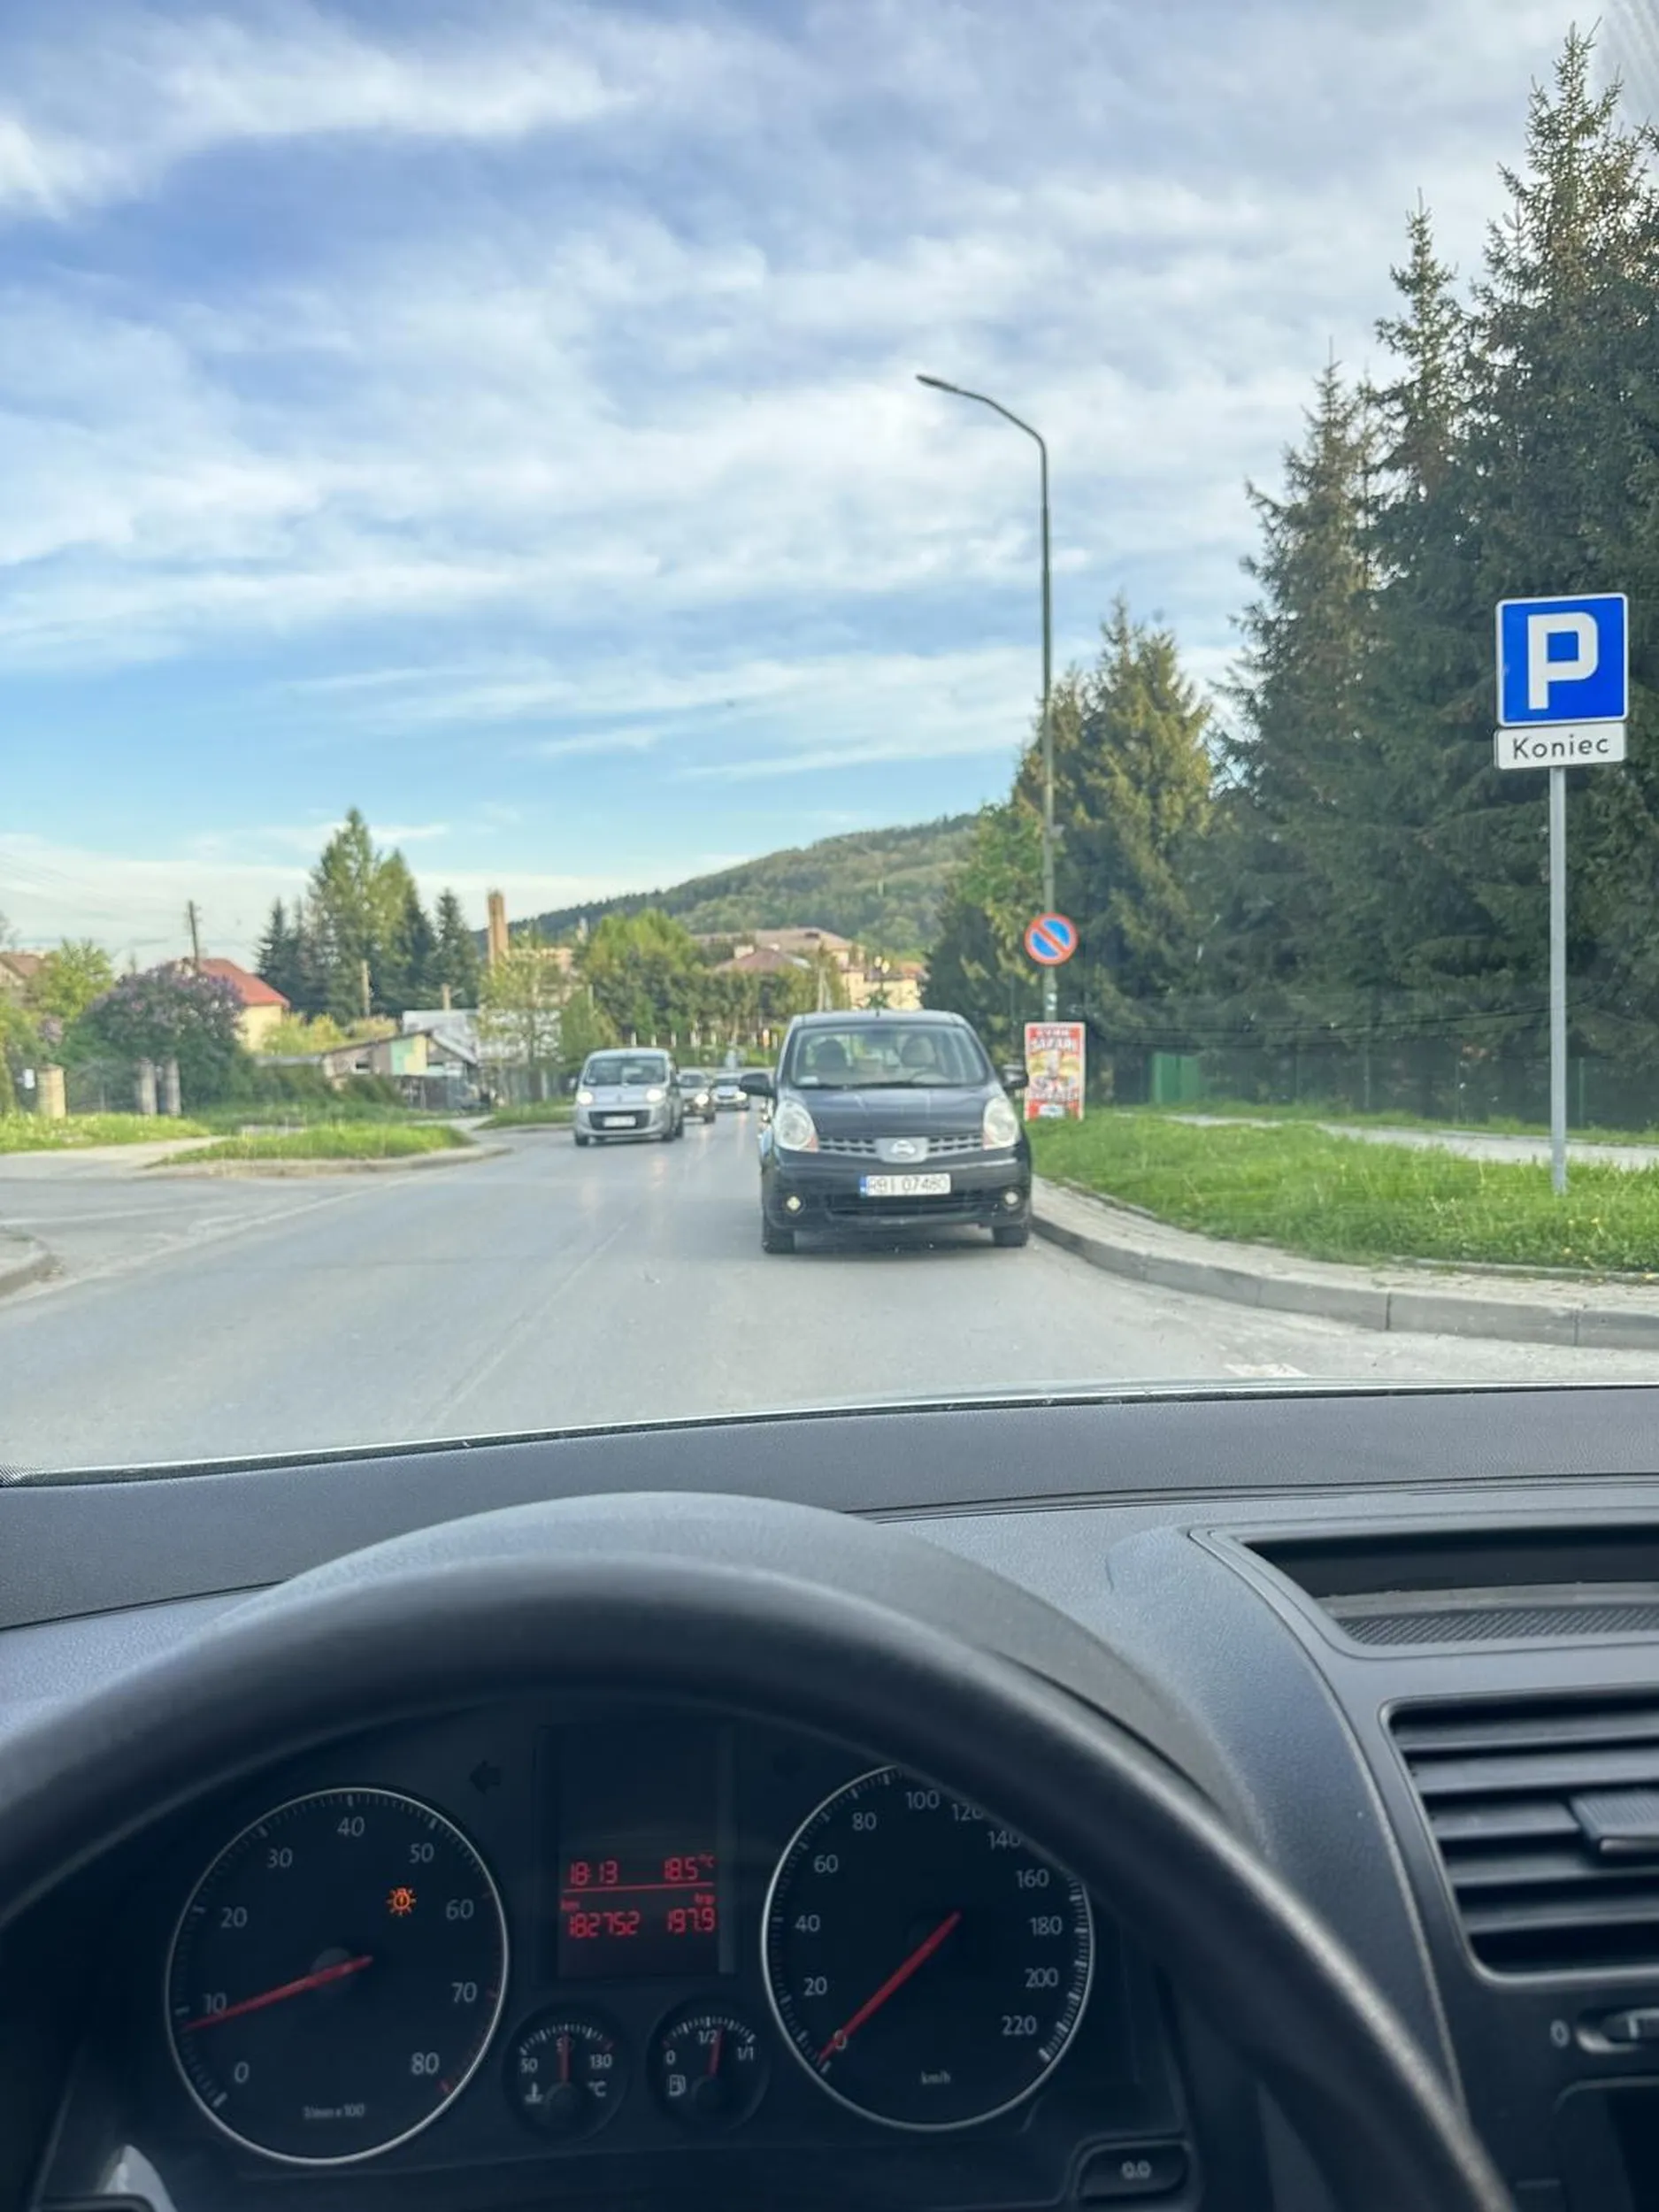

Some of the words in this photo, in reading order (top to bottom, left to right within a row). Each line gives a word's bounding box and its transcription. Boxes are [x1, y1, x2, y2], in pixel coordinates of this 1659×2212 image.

[1528, 611, 1599, 710] P
[1514, 734, 1609, 759] Koniec
[906, 1791, 939, 1809] 100
[337, 1816, 365, 1837] 40
[852, 1813, 876, 1831] 80
[267, 1848, 292, 1868] 30
[410, 1844, 434, 1863] 50
[814, 1855, 838, 1873] 60
[1018, 1870, 1049, 1887] 160
[221, 1908, 247, 1928] 20
[446, 1900, 473, 1919] 60
[570, 1911, 640, 1938] 182752
[795, 1915, 820, 1932] 40
[1031, 1916, 1062, 1935] 180
[804, 1977, 827, 1996] 20
[1025, 1968, 1058, 1987] 200
[452, 1983, 477, 2003] 70
[1002, 2016, 1036, 2035] 220
[411, 2053, 440, 2075] 80
[520, 2058, 538, 2072] 50
[590, 2054, 612, 2069] 130
[666, 2051, 675, 2065] 0
[234, 2062, 249, 2084] 0
